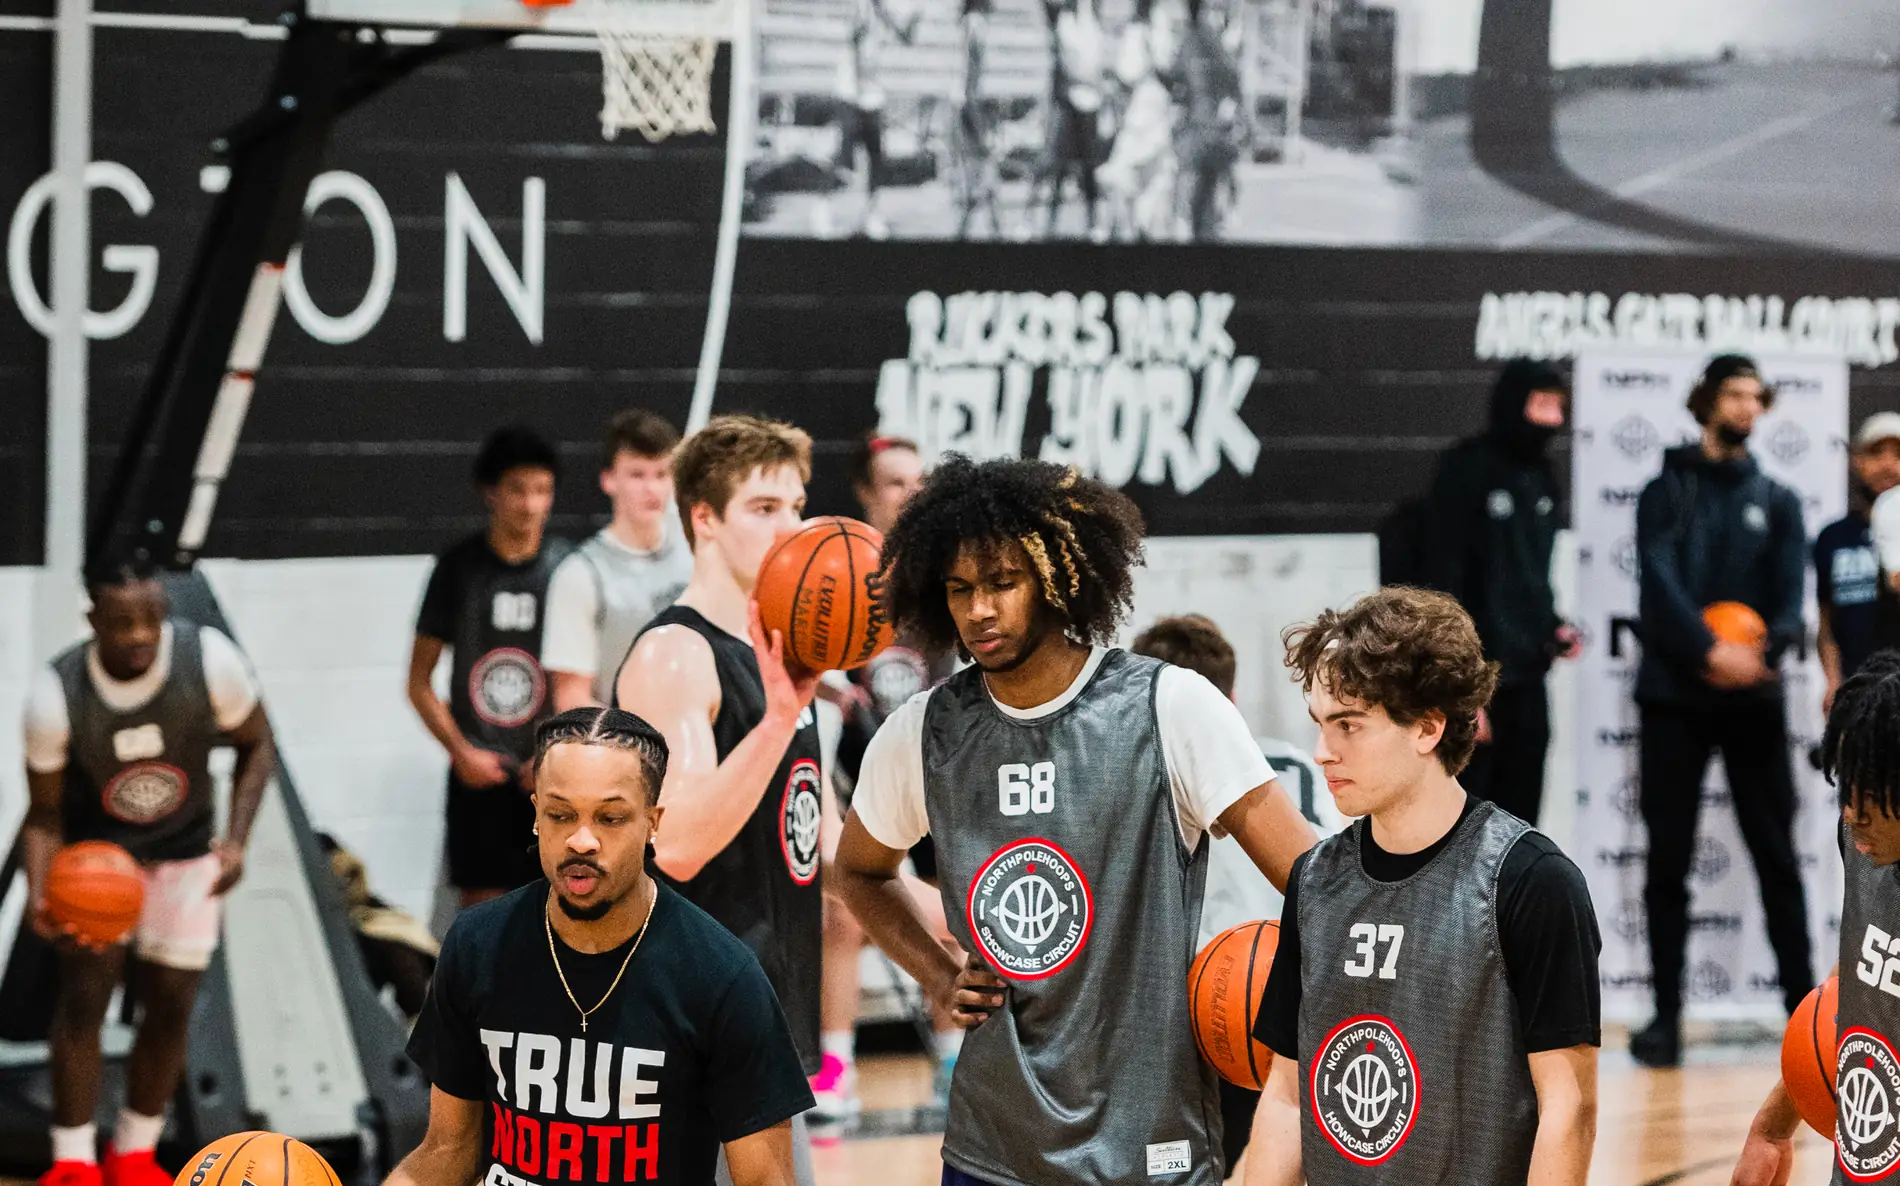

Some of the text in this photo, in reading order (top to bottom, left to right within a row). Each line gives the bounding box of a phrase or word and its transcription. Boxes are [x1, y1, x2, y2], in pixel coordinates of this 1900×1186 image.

[1038, 355, 1261, 495] YORK
[998, 761, 1056, 816] 68
[981, 850, 1075, 897] NORTHPOLEHOOPS
[980, 920, 1081, 969] SHOWCASE CIRCUIT
[1344, 922, 1404, 979] 37
[480, 1028, 665, 1119] TRUE
[1326, 1027, 1407, 1078] NORTHPOLEHOOPS
[492, 1101, 660, 1184] NORTH
[1376, 1109, 1407, 1152] CIRCUIT
[1168, 1160, 1186, 1169] 2XL
